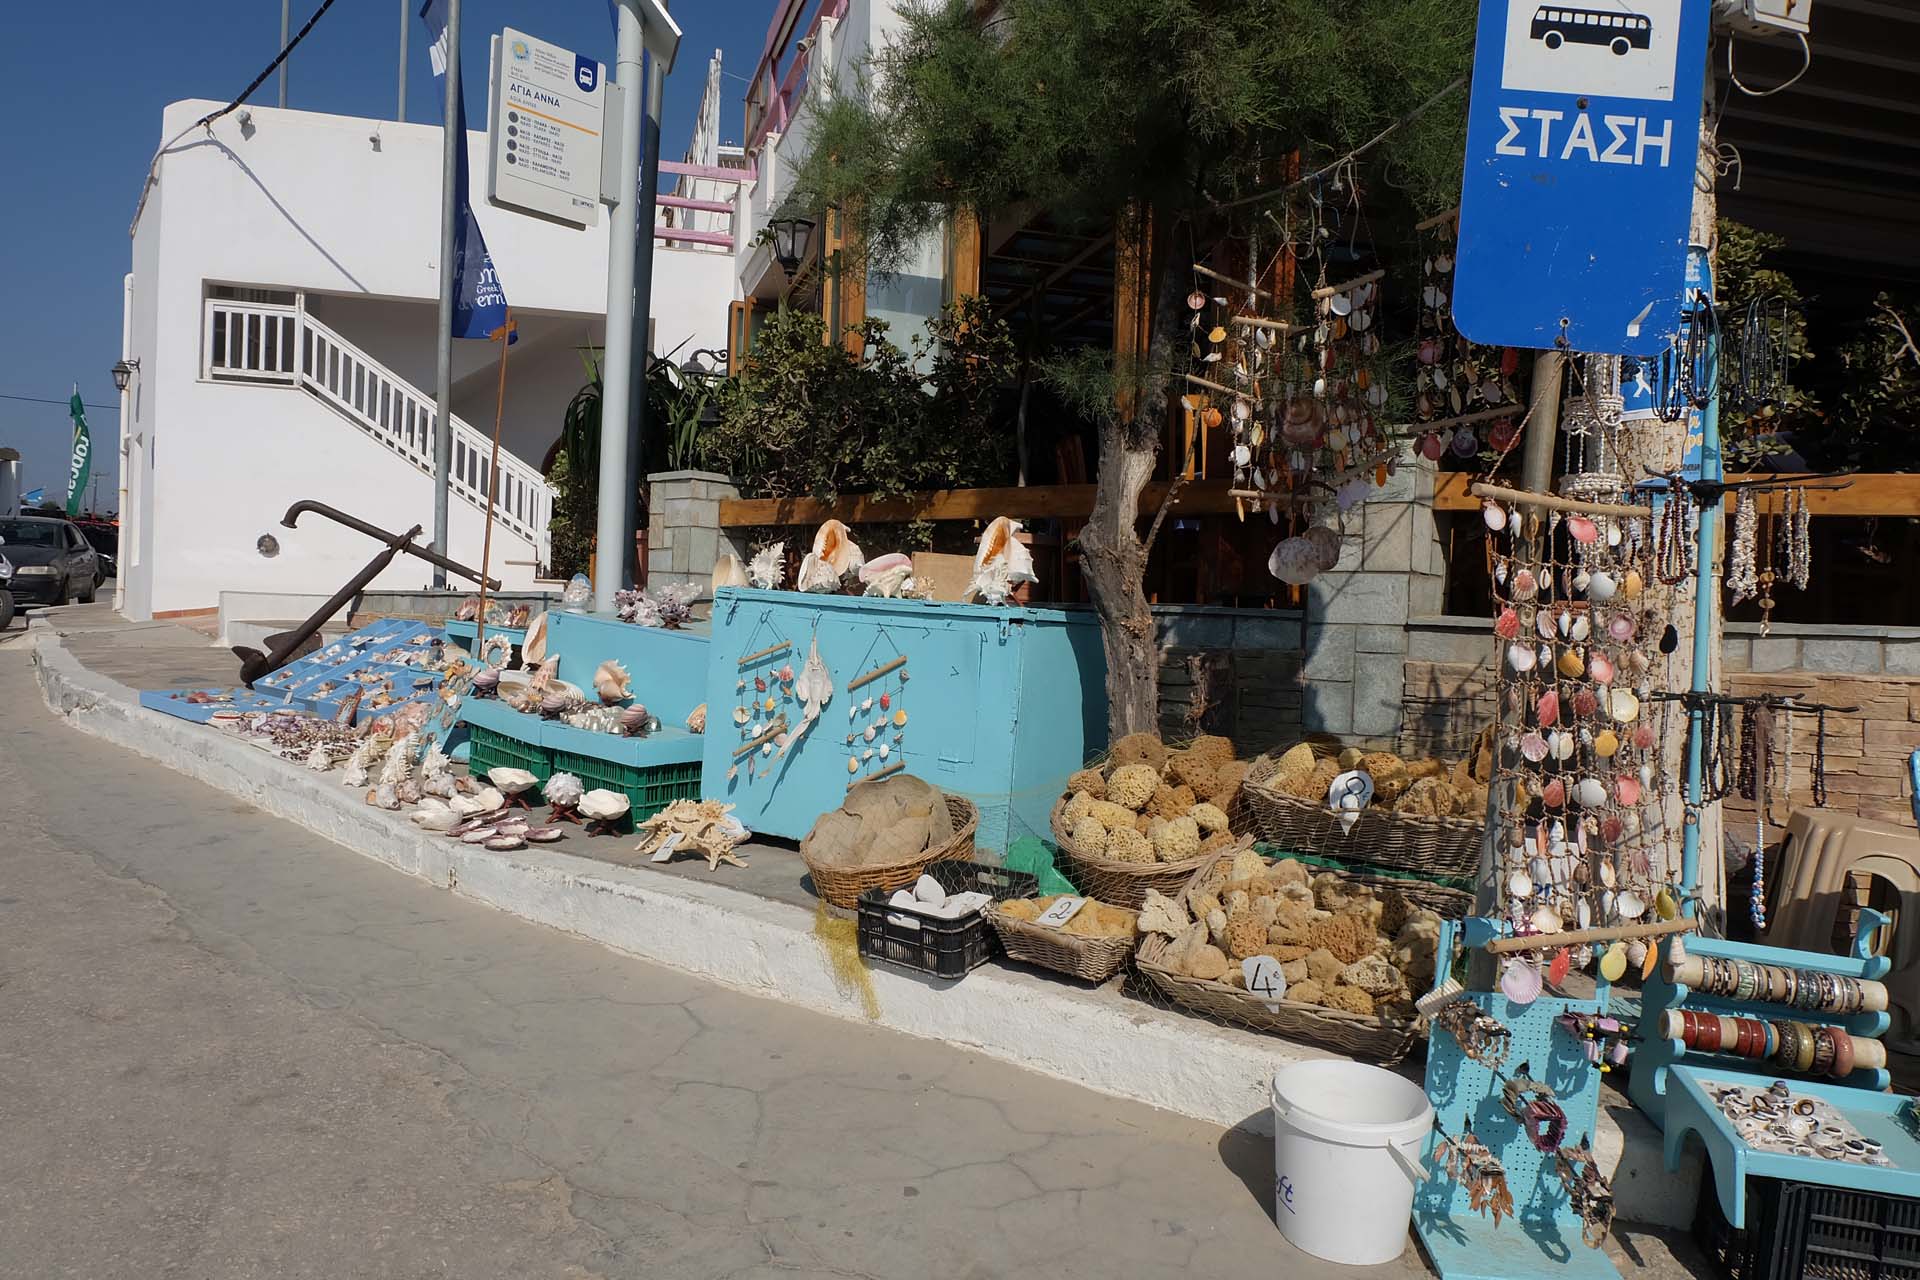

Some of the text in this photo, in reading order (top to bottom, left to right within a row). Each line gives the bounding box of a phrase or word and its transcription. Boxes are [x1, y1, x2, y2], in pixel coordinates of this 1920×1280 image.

[510, 82, 561, 108] ΑΓΙΑ ΑΝΝΑ
[1495, 106, 1673, 168] ΣΤΑΣΗ
[476, 284, 499, 295] Greek
